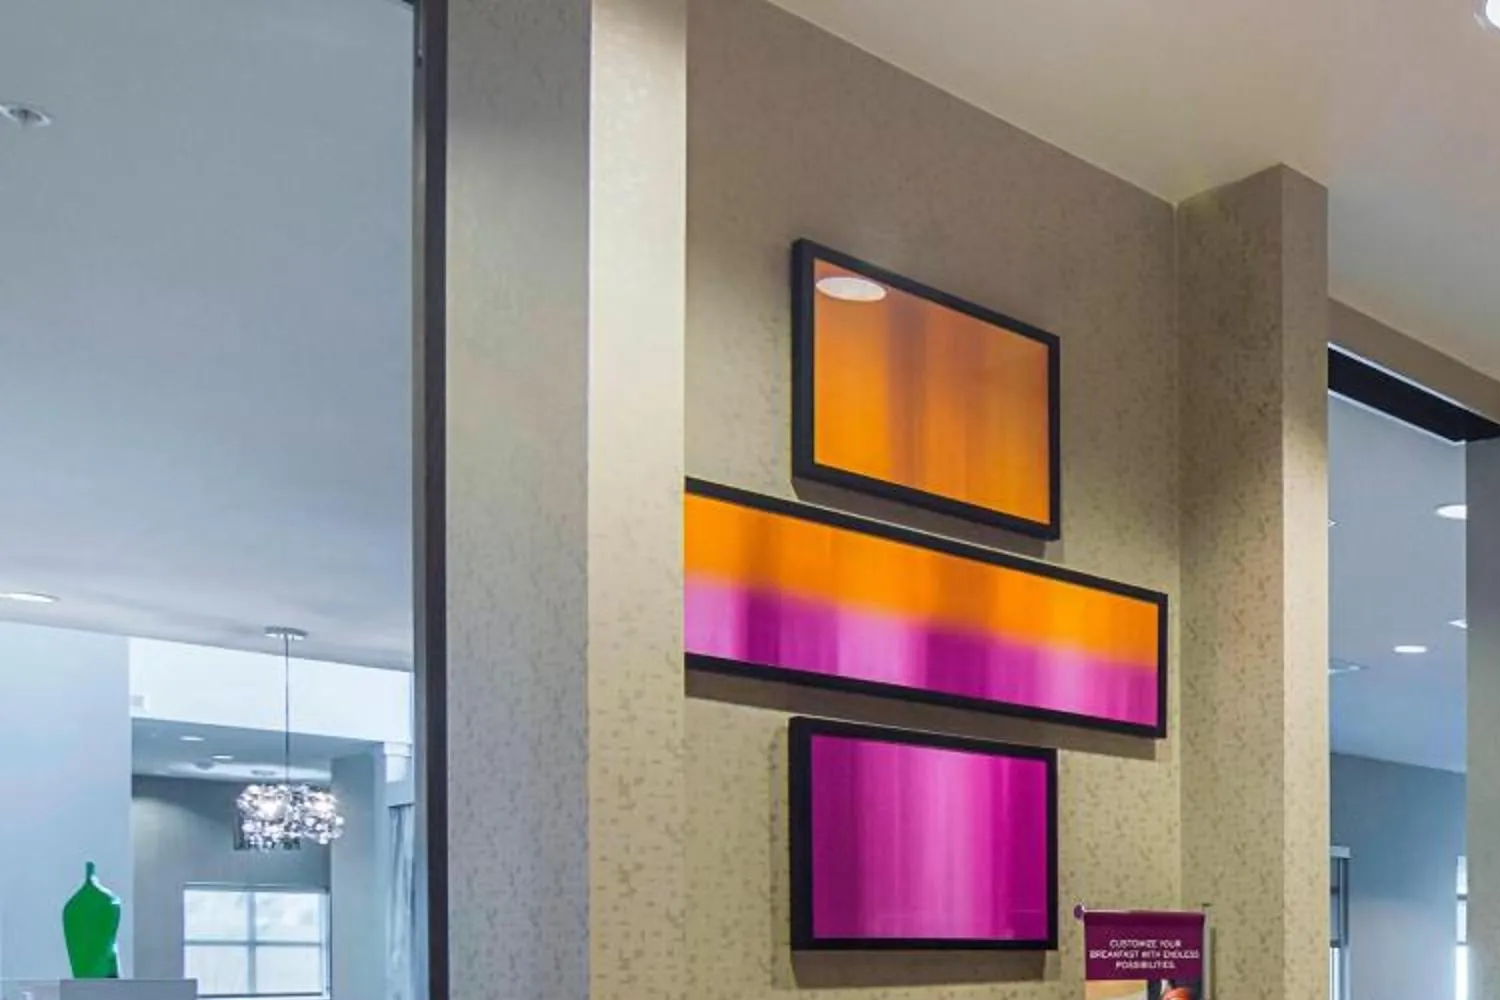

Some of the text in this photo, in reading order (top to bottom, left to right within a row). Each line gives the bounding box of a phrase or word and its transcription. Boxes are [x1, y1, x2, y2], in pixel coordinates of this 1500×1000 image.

[1109, 939, 1181, 949] CUSTOMIZE YOUR
[1089, 950, 1200, 959] BREAKFAST WITH ENDLESS
